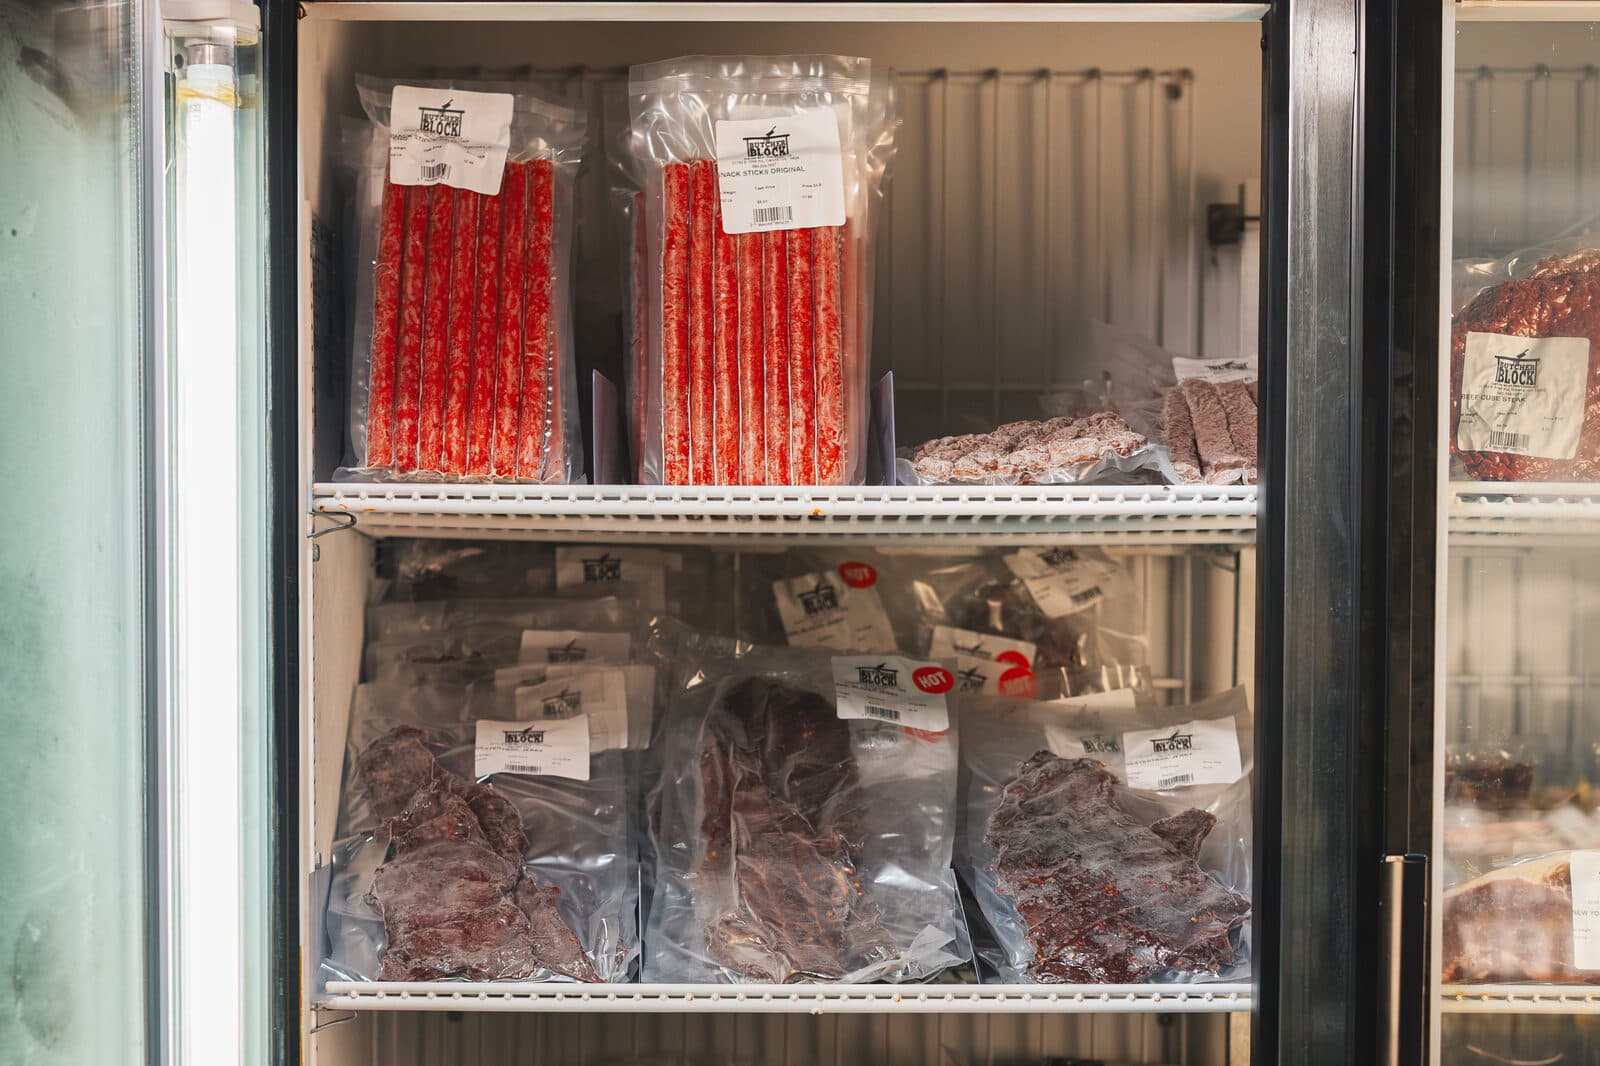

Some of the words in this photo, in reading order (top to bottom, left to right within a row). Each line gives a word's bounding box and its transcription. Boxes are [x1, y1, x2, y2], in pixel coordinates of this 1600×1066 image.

[423, 120, 458, 137] BLOCK
[750, 146, 786, 157] BLOCK
[742, 169, 769, 177] STICKS
[770, 165, 806, 175] ORIGINAL
[1498, 368, 1535, 385] BLOCK
[863, 673, 896, 687] BLOCK
[917, 671, 947, 689] HOT
[507, 732, 542, 743] BLOCK
[1155, 740, 1189, 752] BLOCK
